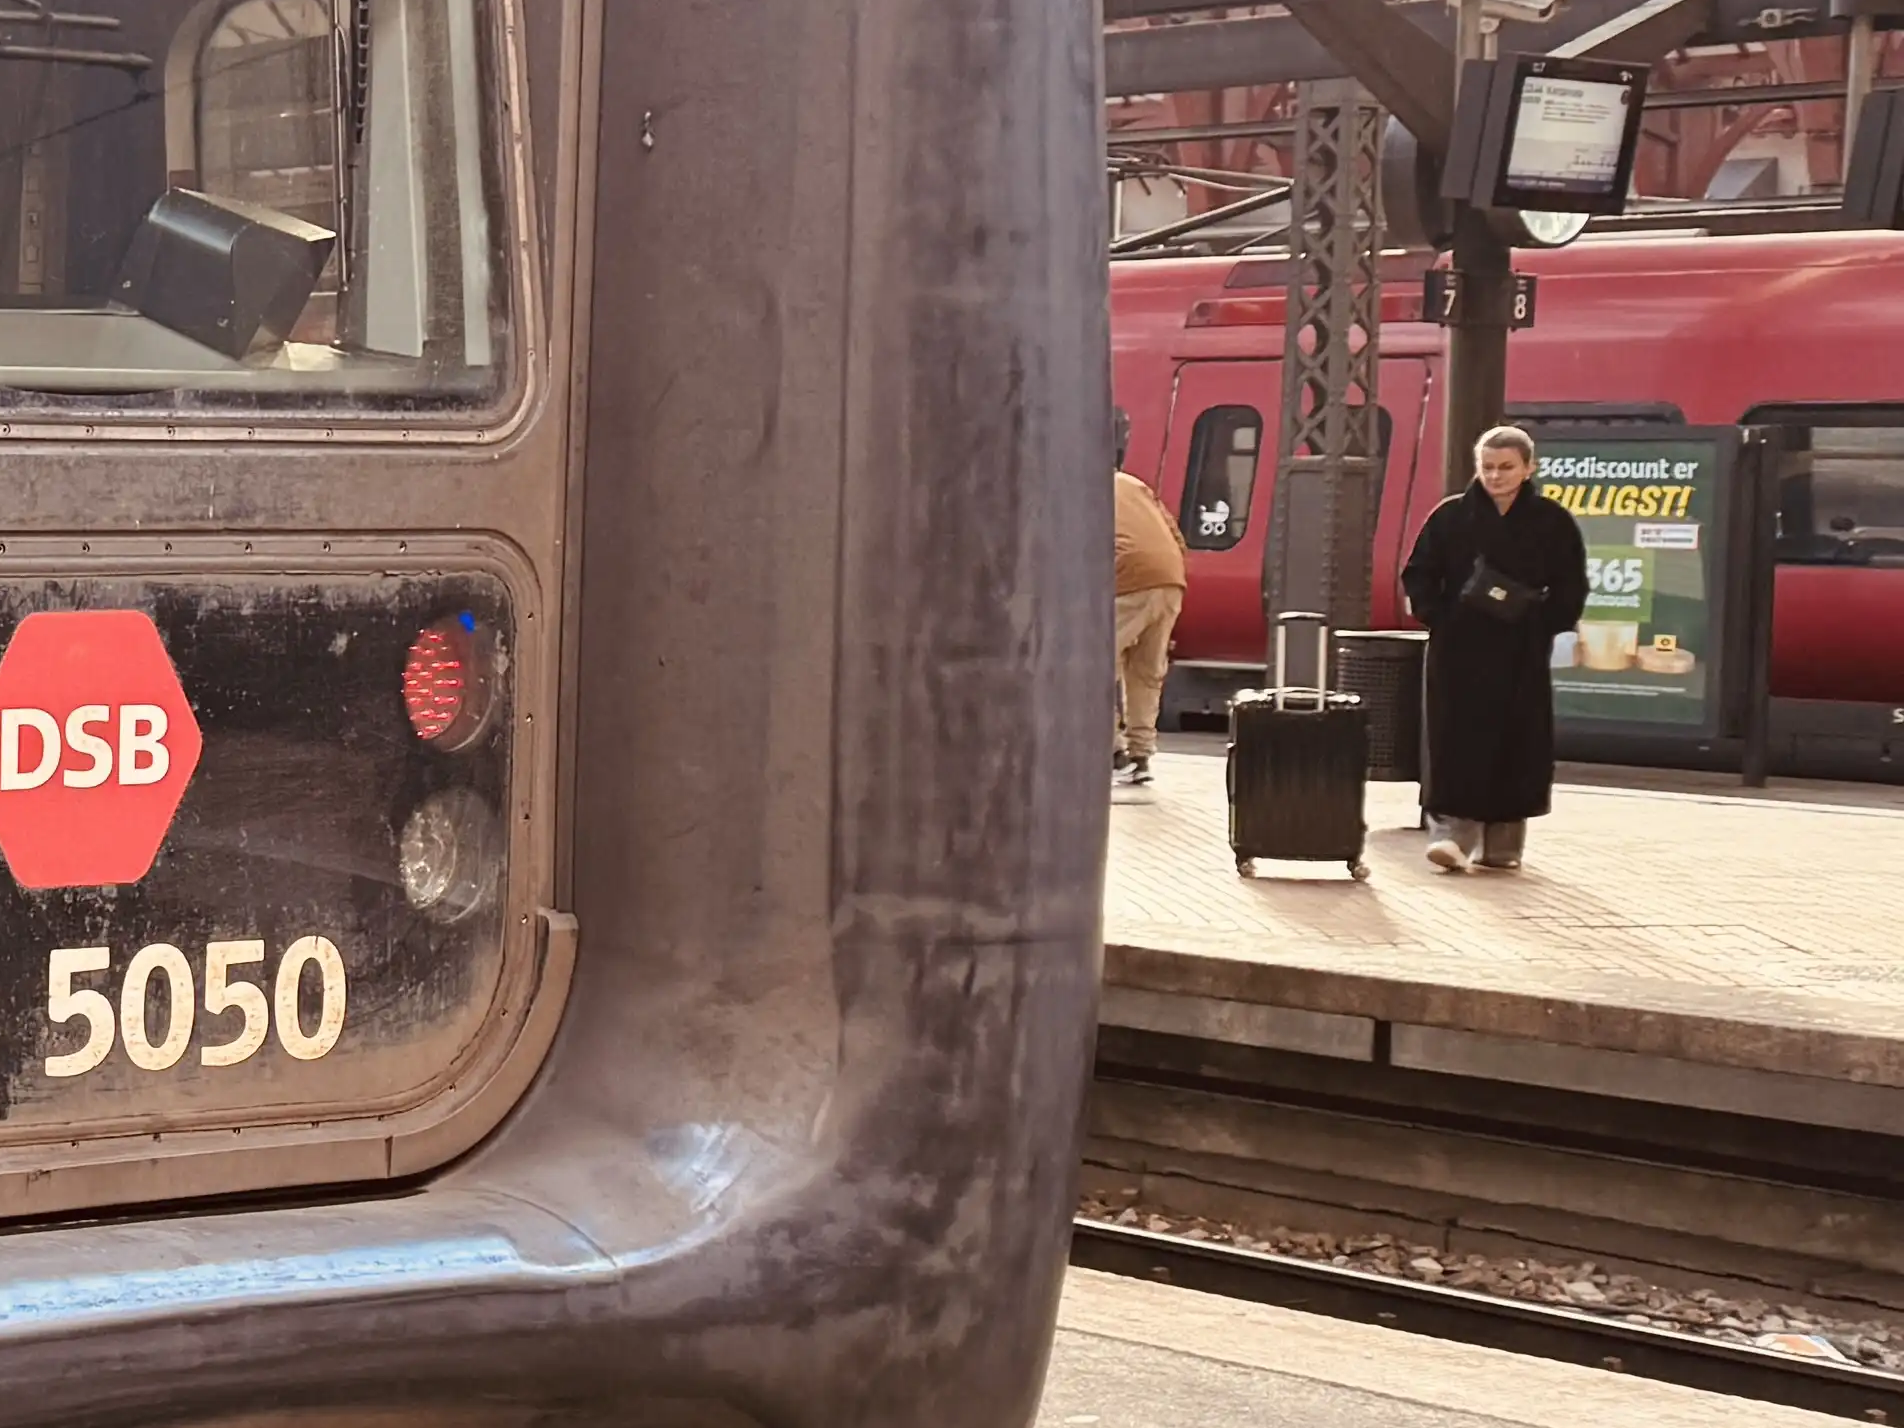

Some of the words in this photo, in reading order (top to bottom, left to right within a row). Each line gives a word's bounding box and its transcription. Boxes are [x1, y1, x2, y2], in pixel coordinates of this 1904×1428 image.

[1443, 289, 1456, 316] 7
[1514, 293, 1527, 320] 8
[1537, 456, 1670, 479] 365discount
[1674, 461, 1699, 480] er
[1585, 557, 1643, 593] 365
[0, 703, 171, 791] DSB
[44, 935, 347, 1078] 5050
